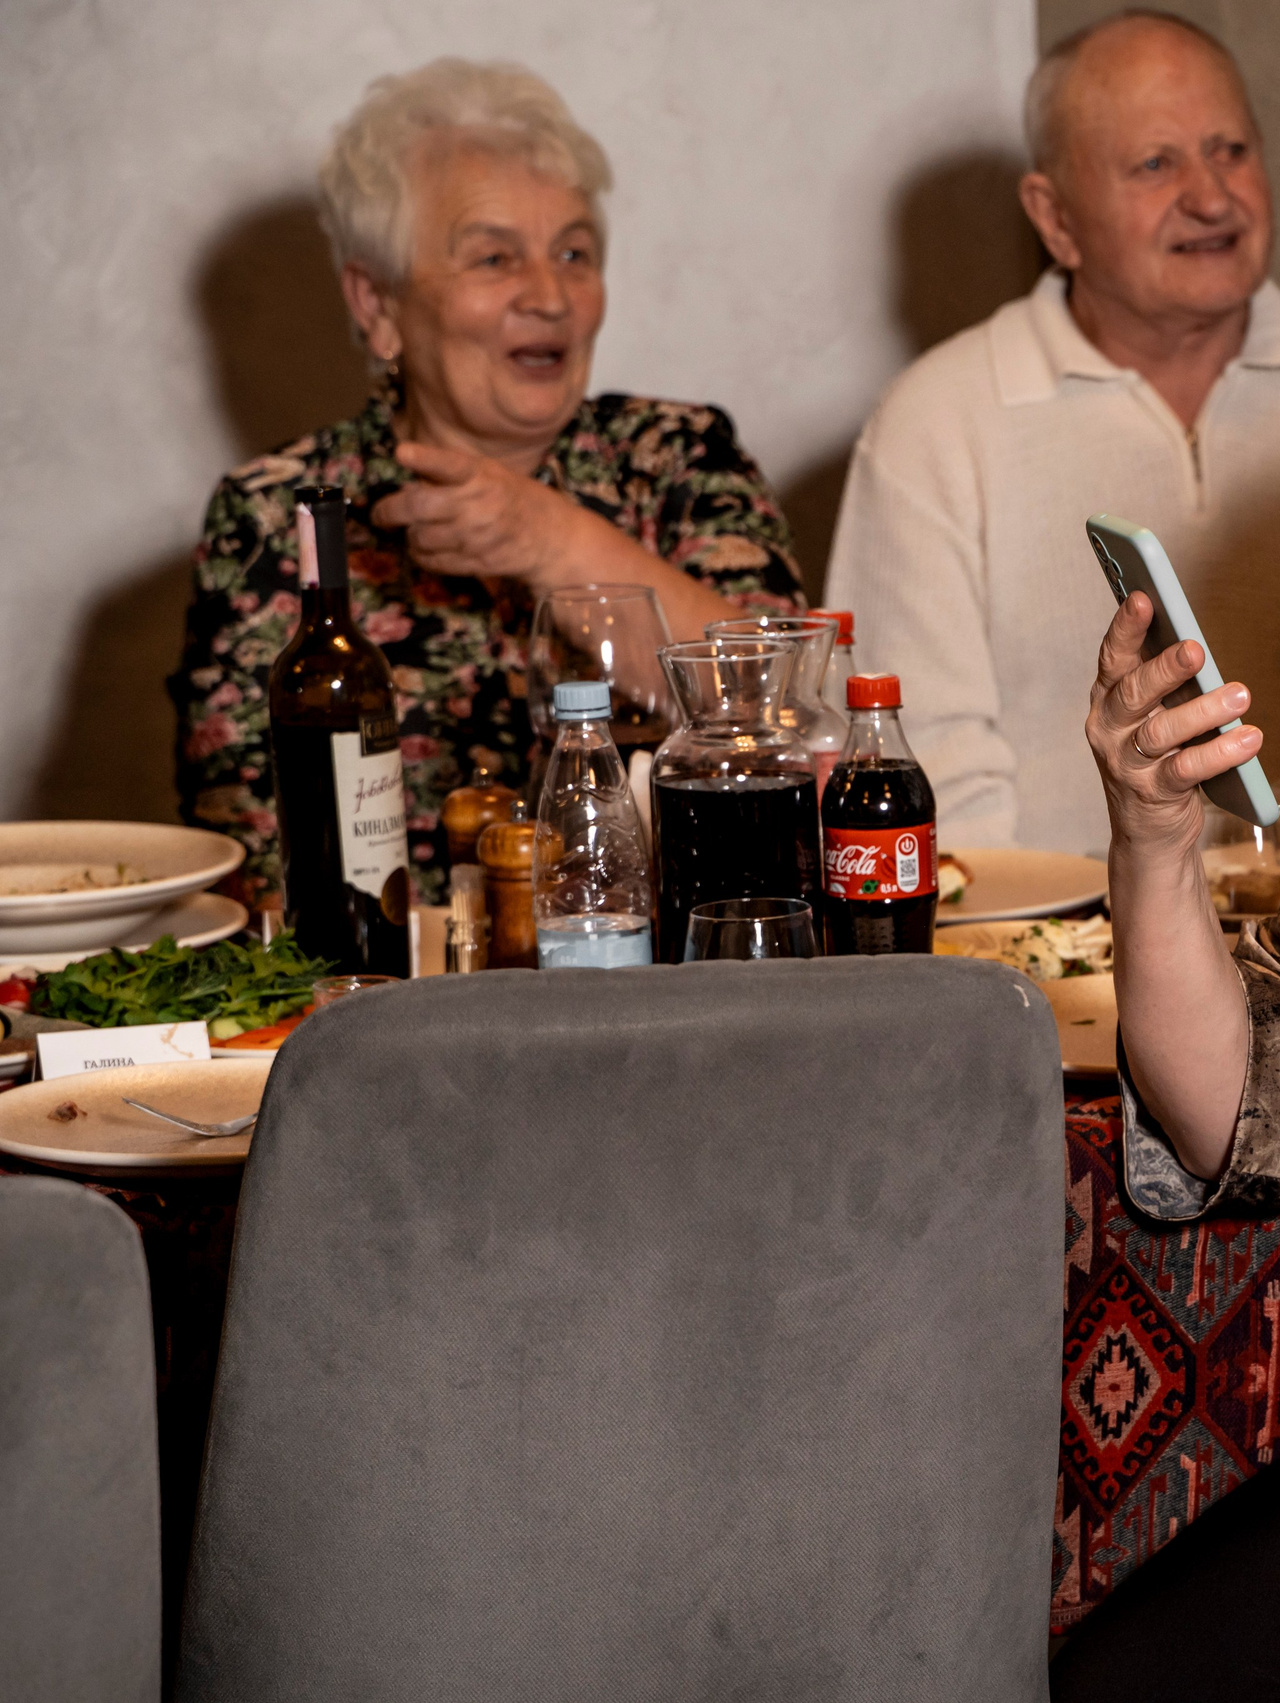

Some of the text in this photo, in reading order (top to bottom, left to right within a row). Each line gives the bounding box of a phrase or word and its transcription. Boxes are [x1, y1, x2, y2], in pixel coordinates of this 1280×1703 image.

[353, 816, 405, 838] КИНДЗМ
[825, 844, 882, 875] ca-Cola
[84, 1057, 135, 1070] ГАЛИНА
